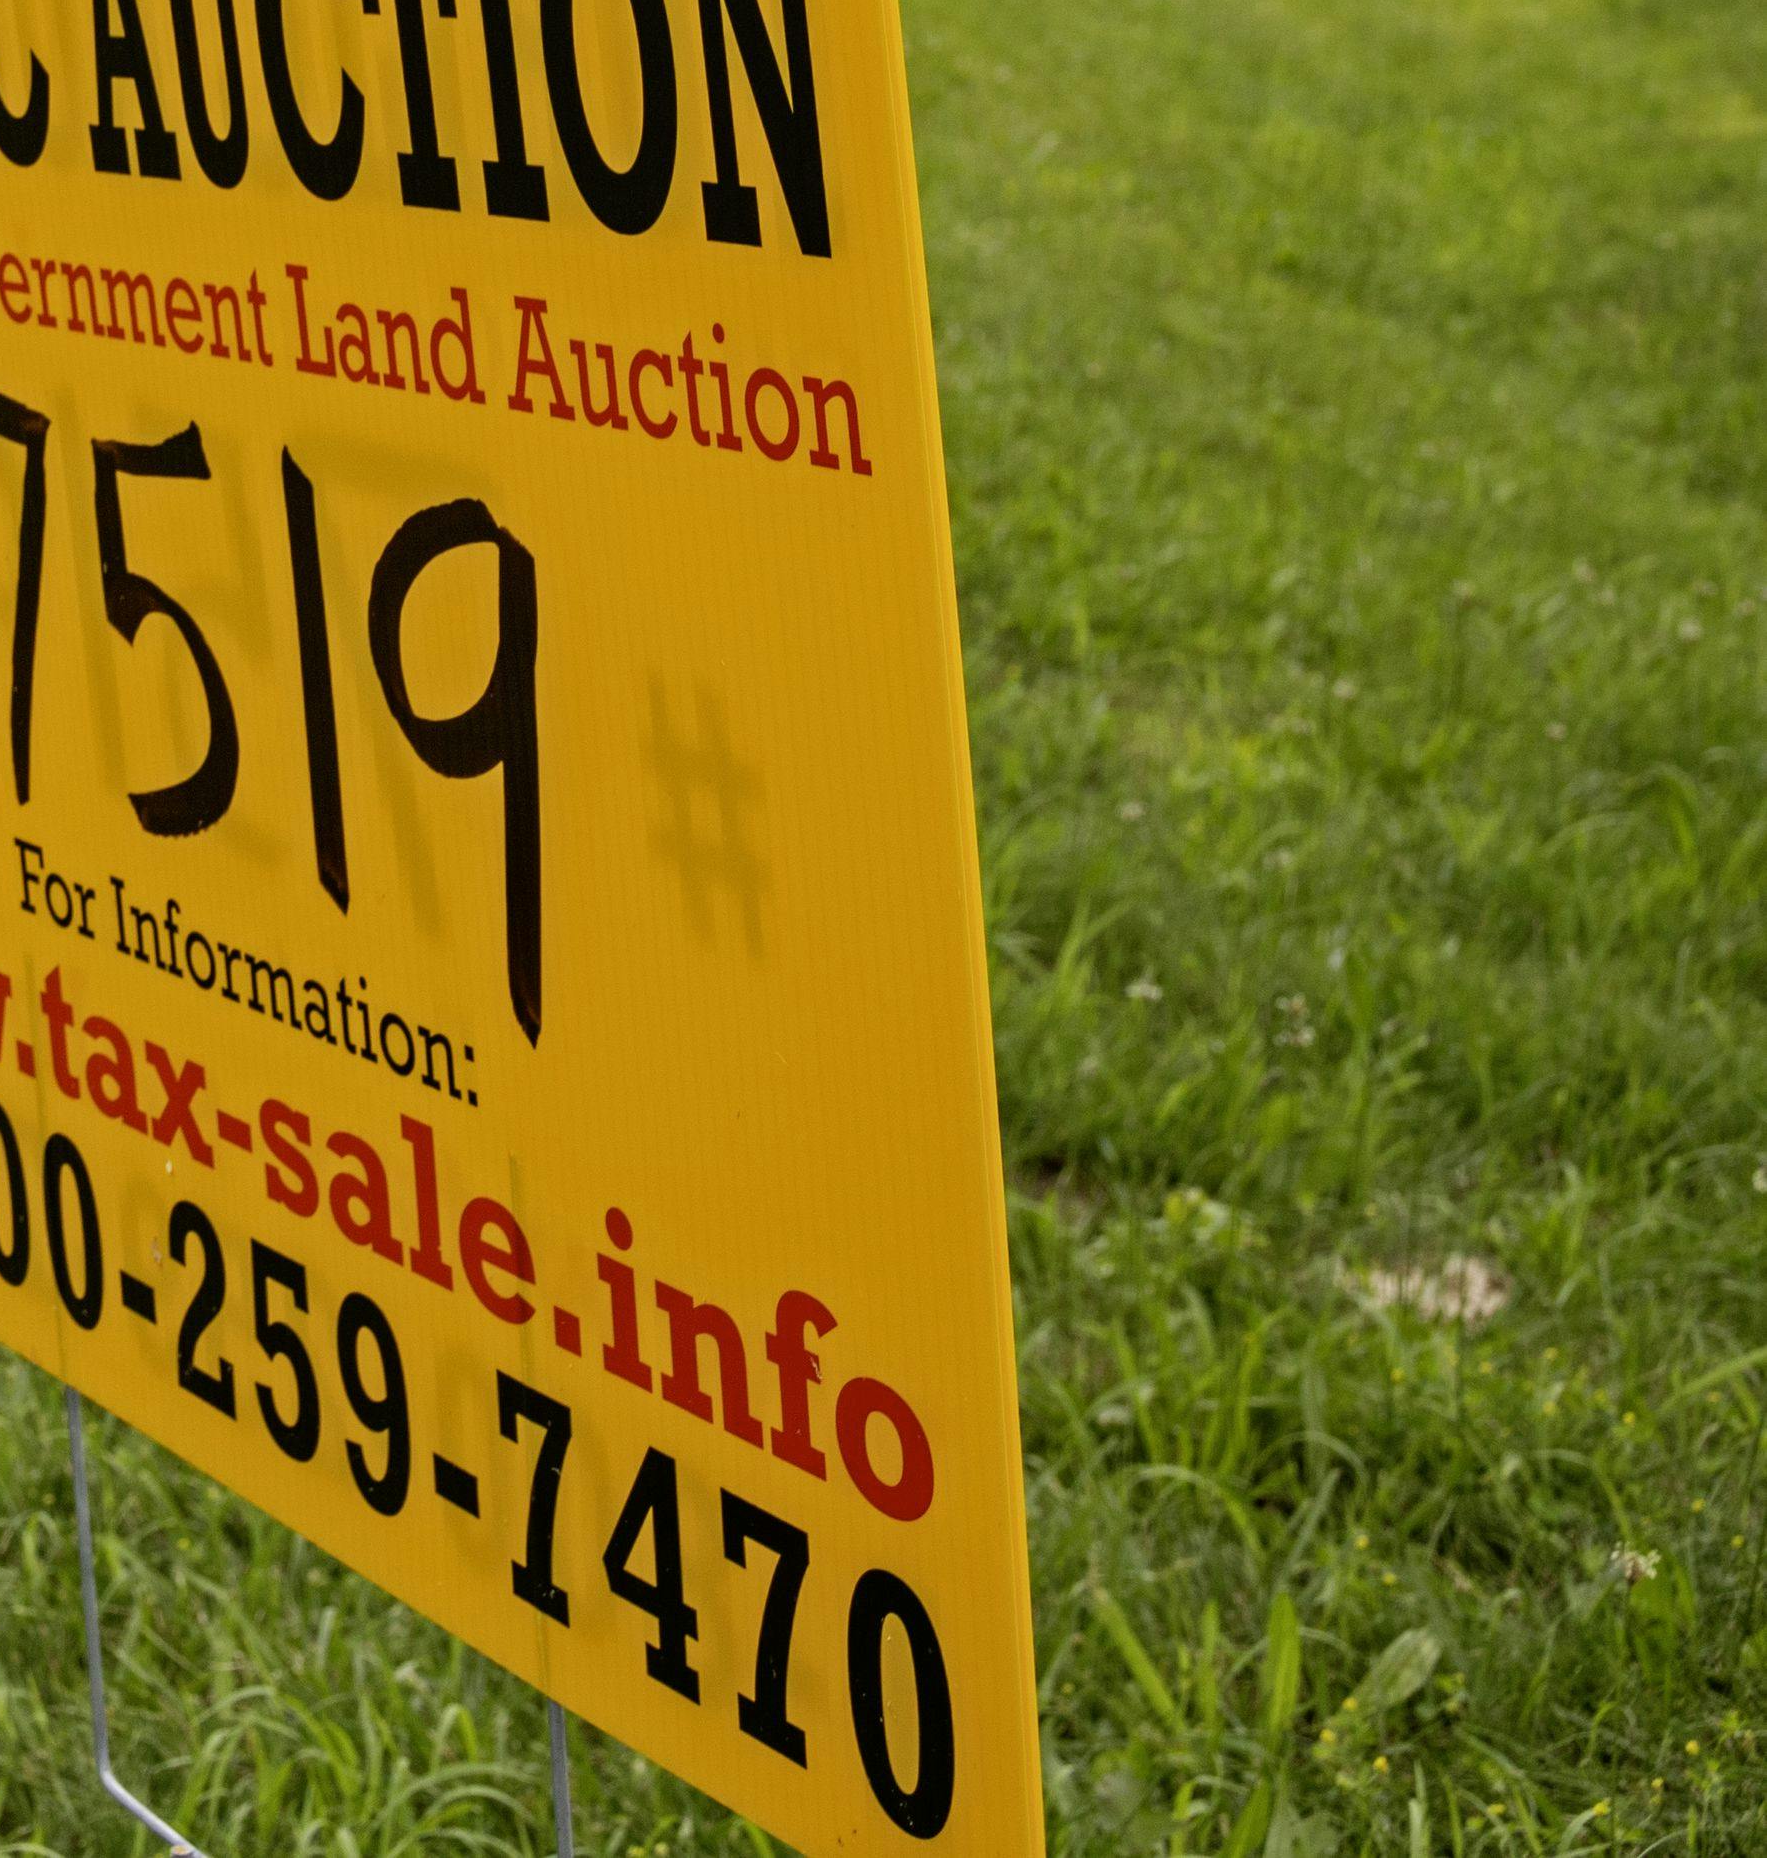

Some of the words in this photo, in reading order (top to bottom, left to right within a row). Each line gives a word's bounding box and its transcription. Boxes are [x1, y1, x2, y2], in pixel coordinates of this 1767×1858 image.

[284, 263, 485, 404] Land
[508, 296, 873, 478] Auction
[15, 838, 97, 939] For
[110, 874, 481, 1107] Information:
